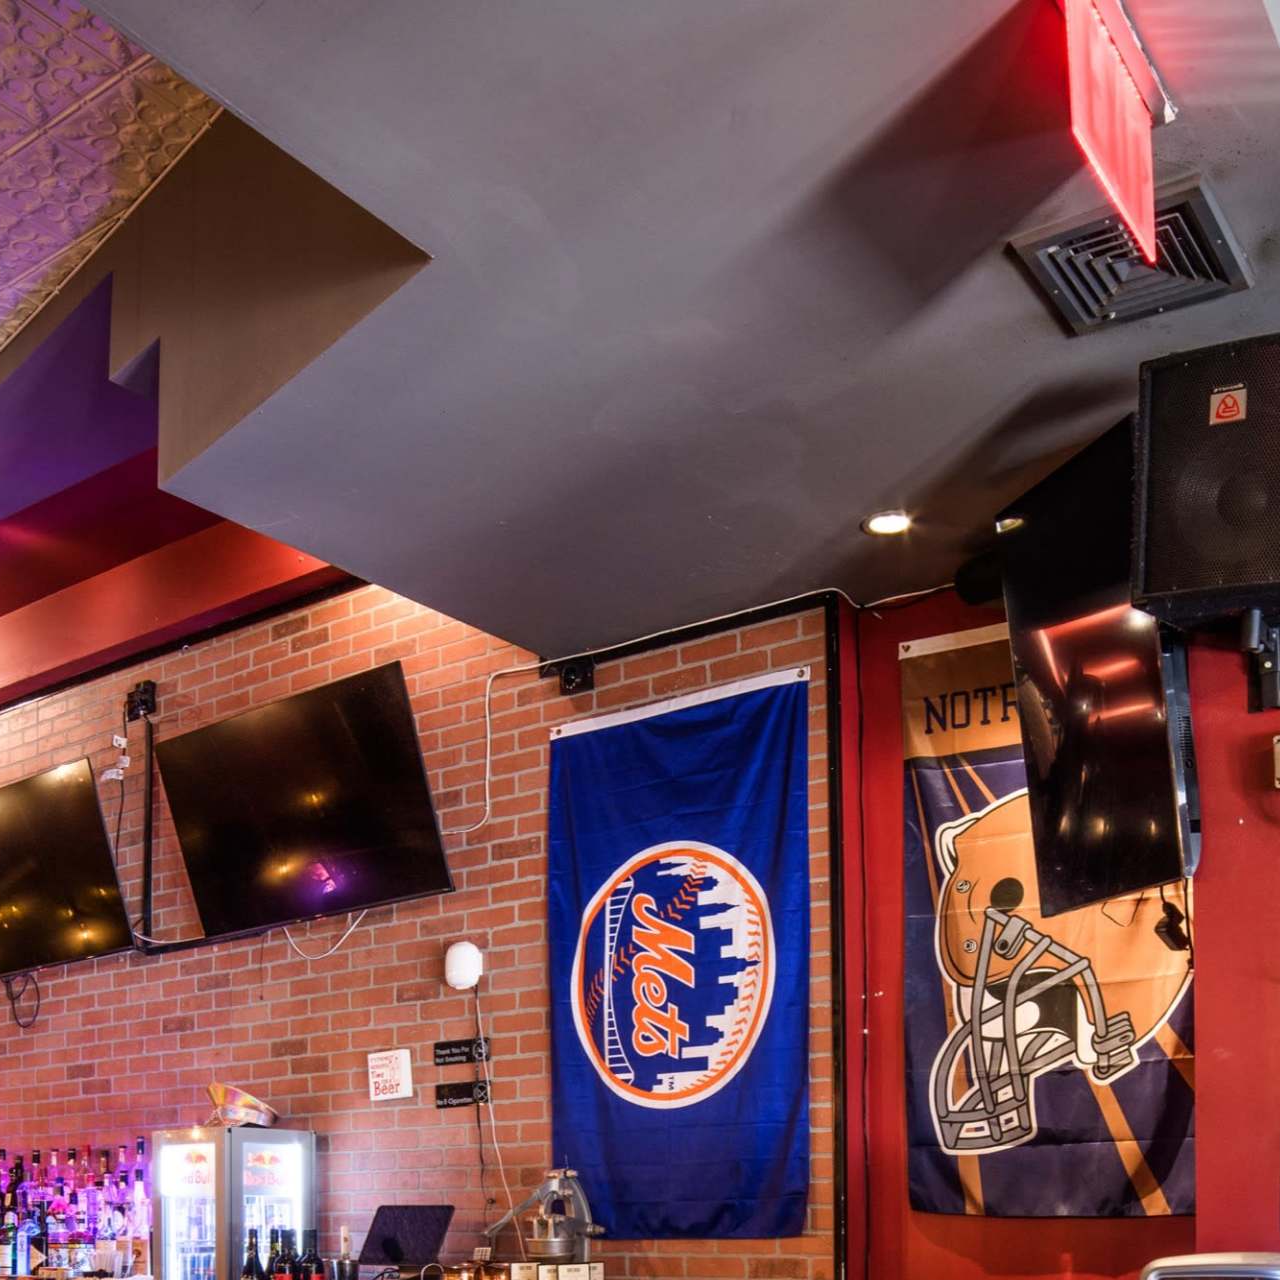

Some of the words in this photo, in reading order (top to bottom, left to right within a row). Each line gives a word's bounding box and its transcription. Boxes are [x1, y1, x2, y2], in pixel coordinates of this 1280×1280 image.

[631, 893, 695, 1059] Mets
[374, 1081, 400, 1096] Beer
[667, 1075, 675, 1091] TM
